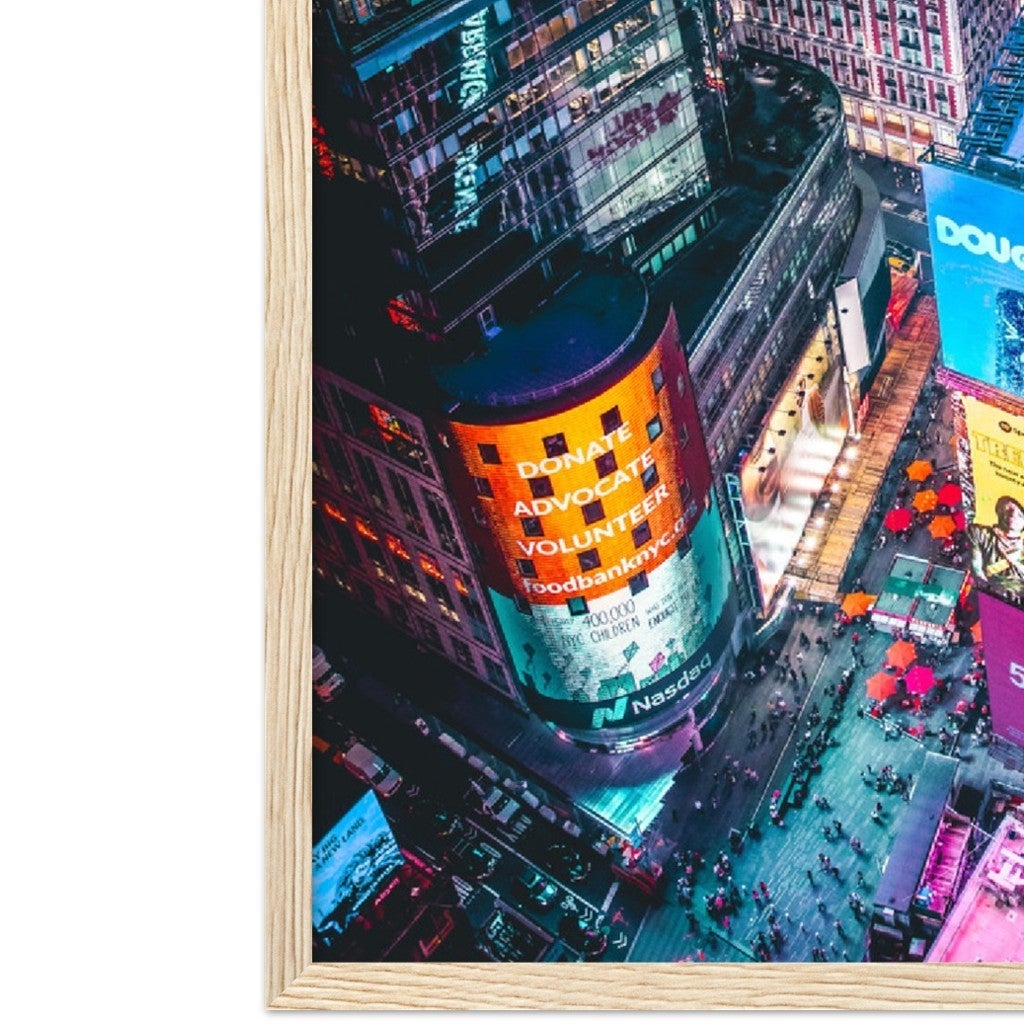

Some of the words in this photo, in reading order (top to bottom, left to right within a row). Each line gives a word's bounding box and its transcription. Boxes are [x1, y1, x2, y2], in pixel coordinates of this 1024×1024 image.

[513, 446, 656, 517] ADVOCATE
[516, 420, 633, 480] DONATE
[516, 482, 671, 557] VOLUNTEER
[590, 614, 641, 644] CHILDREN
[631, 652, 713, 716] Nasdaq
